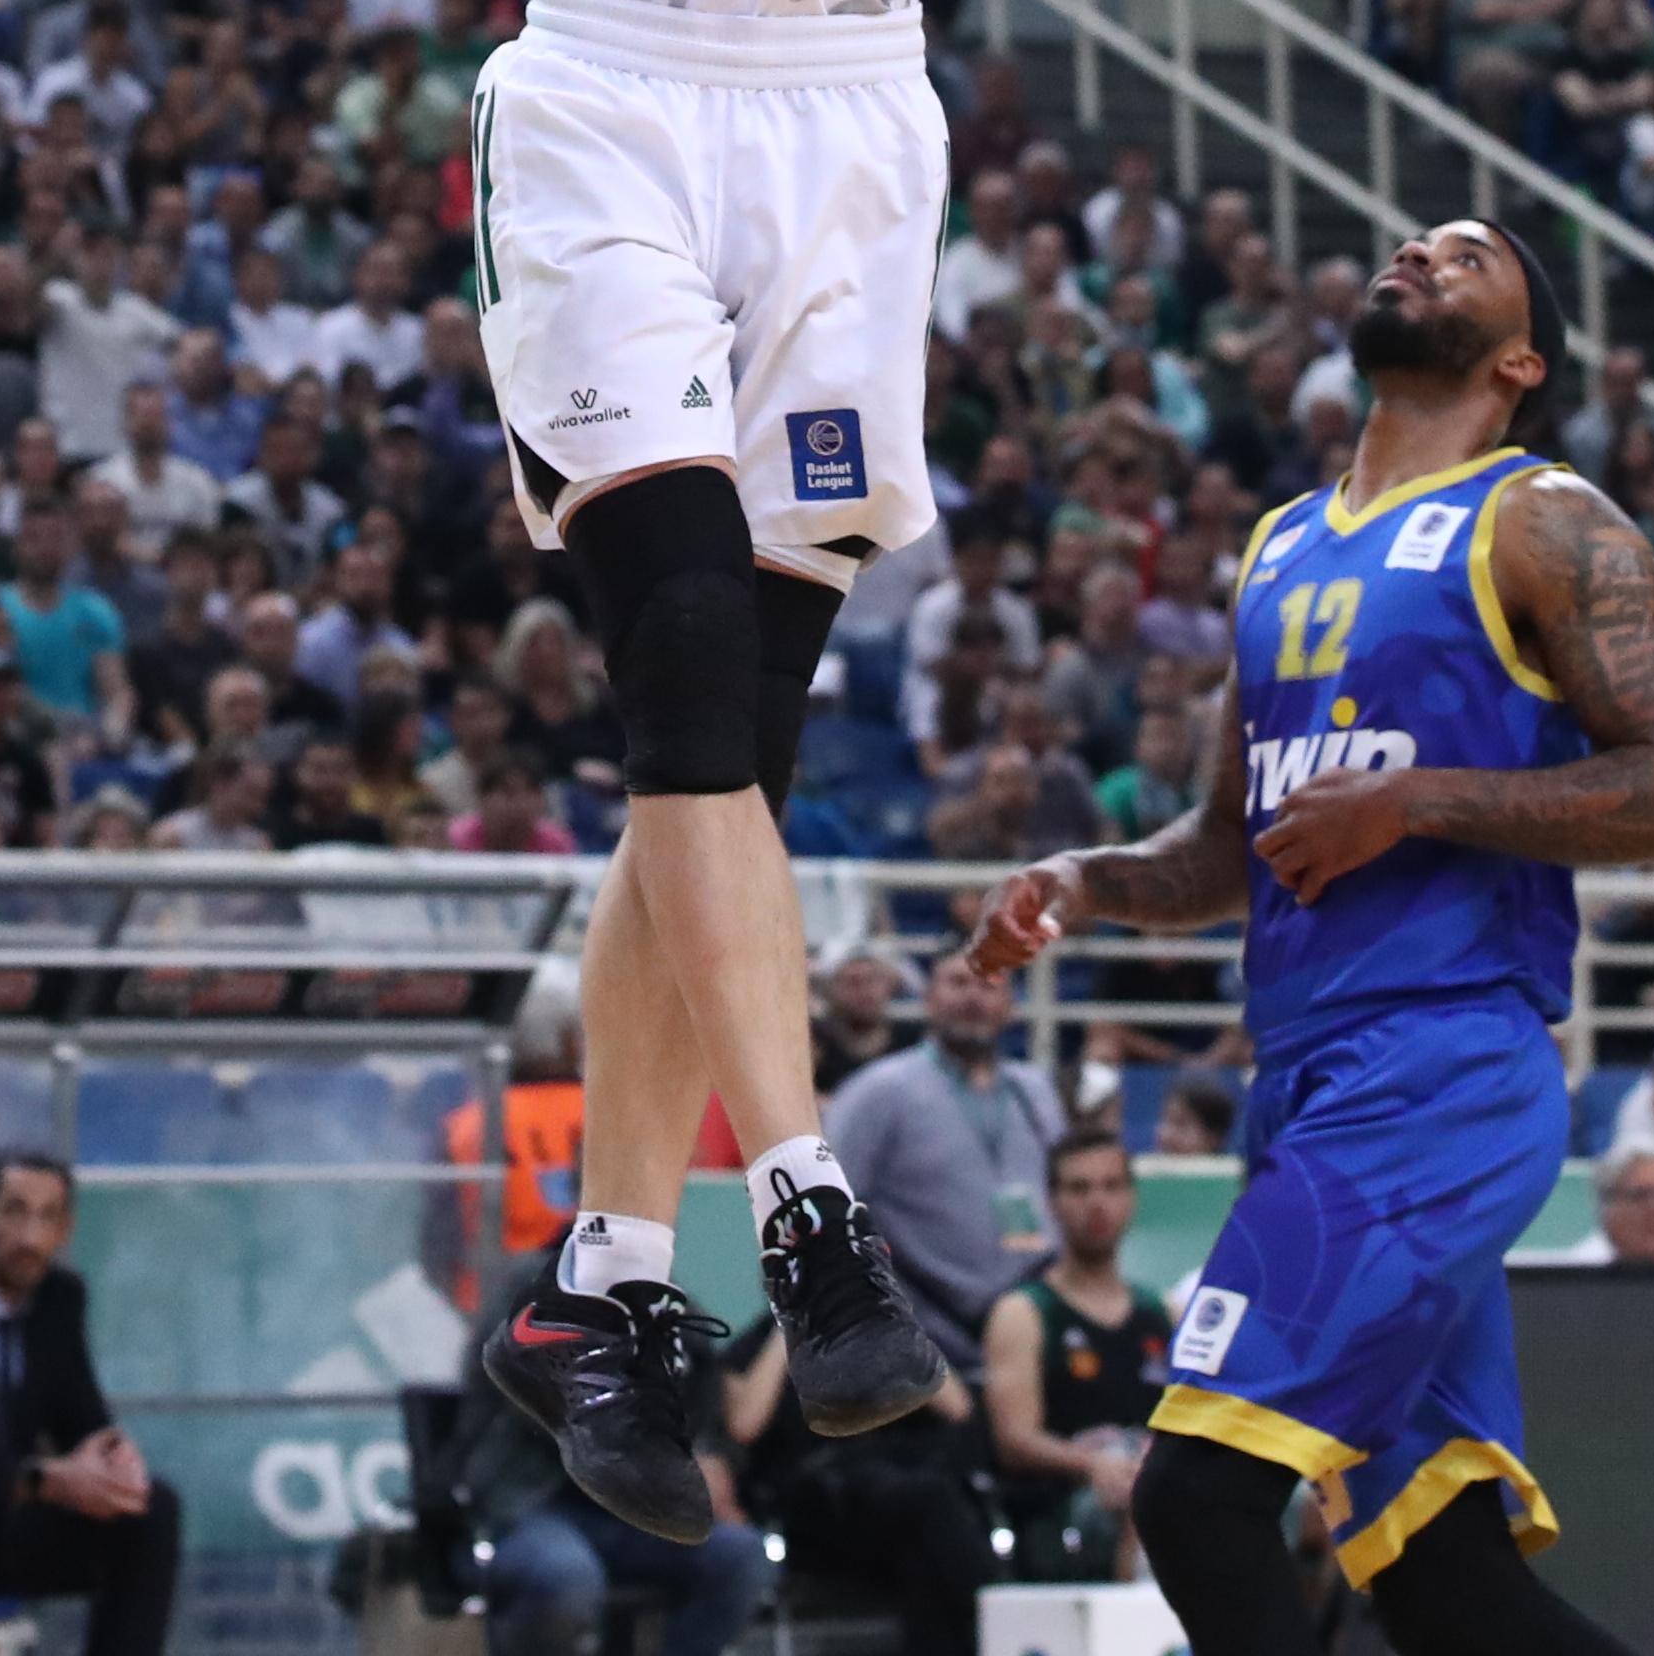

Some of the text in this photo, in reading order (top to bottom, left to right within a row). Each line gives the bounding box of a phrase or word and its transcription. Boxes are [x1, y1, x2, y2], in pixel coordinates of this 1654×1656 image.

[806, 461, 852, 475] Basket
[808, 476, 854, 491] League
[1277, 577, 1364, 682] 12
